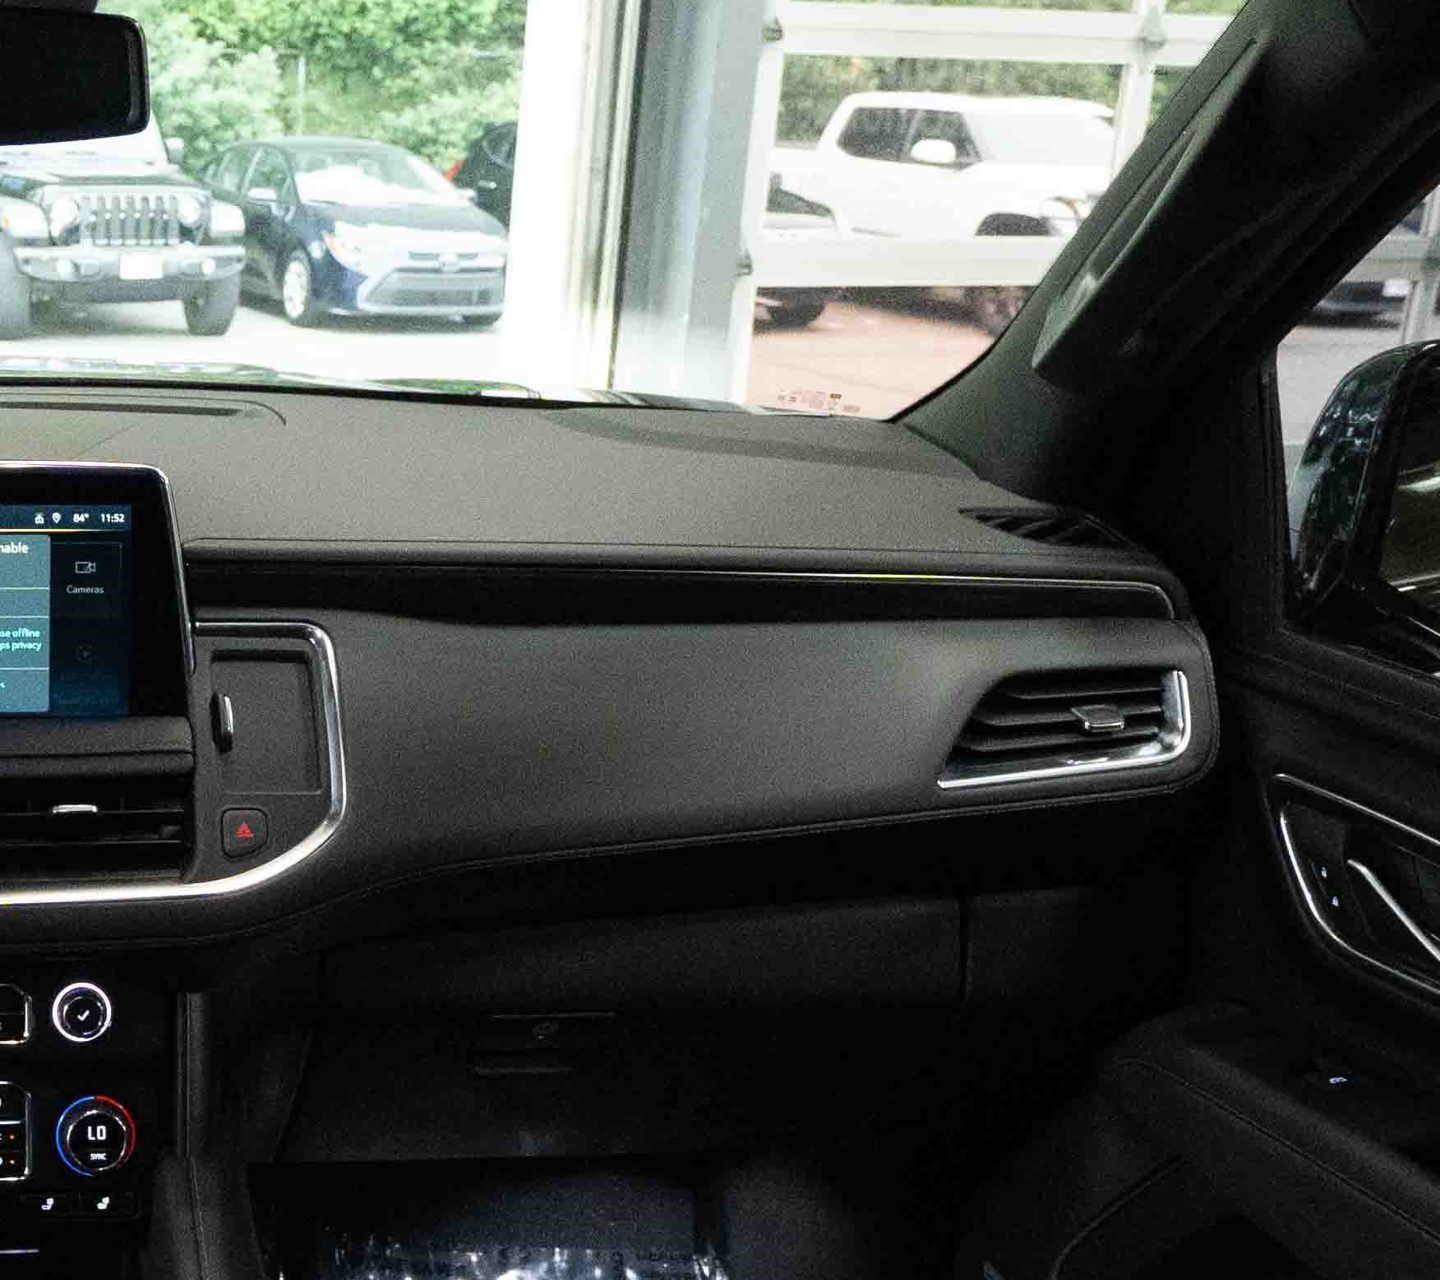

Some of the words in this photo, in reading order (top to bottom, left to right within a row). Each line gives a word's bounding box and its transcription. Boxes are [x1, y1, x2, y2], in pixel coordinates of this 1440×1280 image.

[100, 513, 125, 523] 11:52
[66, 585, 104, 595] Cameras
[12, 628, 40, 638] offline
[11, 642, 42, 653] privacy
[87, 1125, 106, 1141] LO
